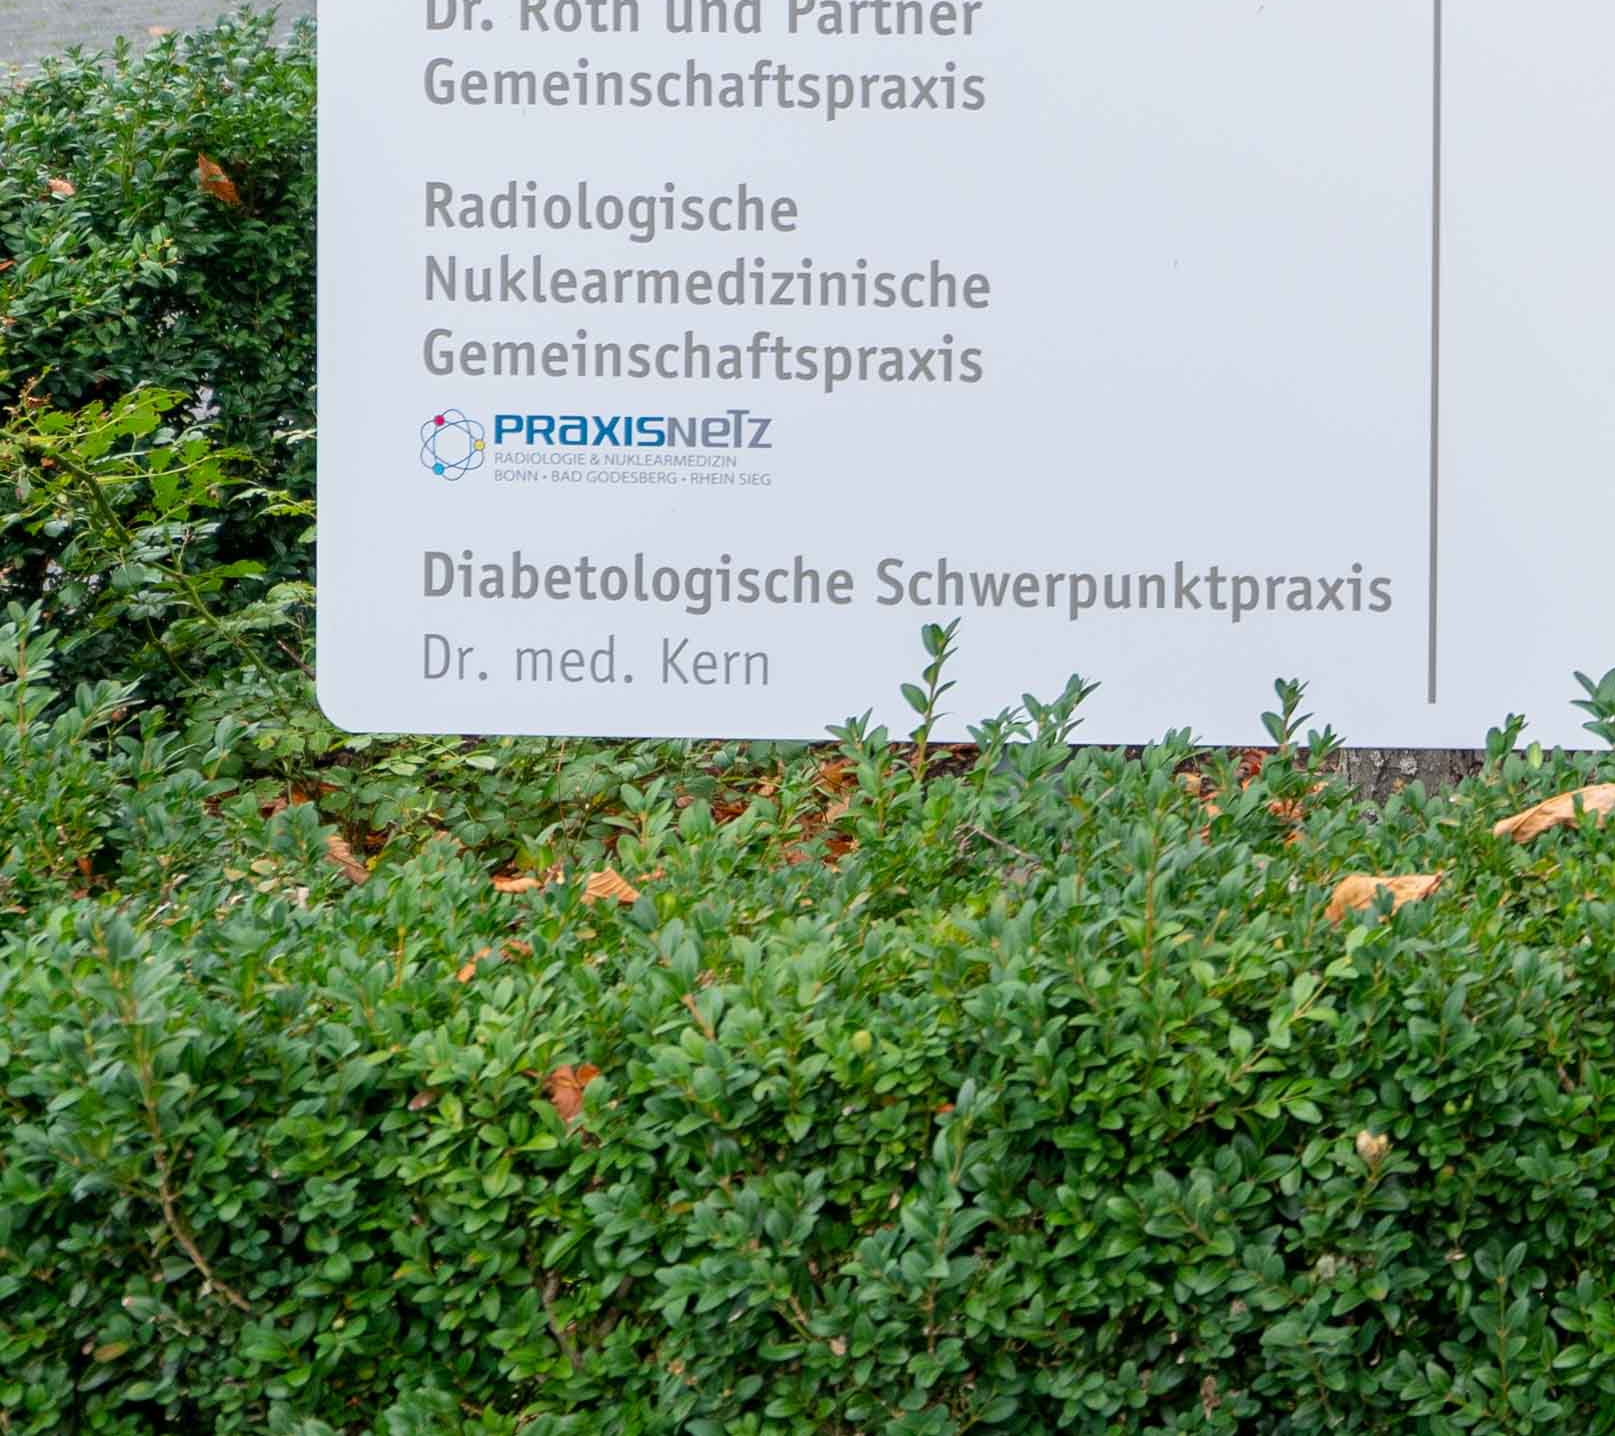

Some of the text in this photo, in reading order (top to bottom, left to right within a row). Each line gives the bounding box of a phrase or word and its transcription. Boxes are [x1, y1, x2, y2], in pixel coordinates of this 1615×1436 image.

[423, 57, 986, 122] Gemeinschaftspraxis
[425, 179, 798, 244] Radiologische
[425, 253, 992, 309] Nuklearmedizinische
[423, 327, 984, 394] Gemeinschaftspraxis
[493, 450, 737, 468] RADIOLOGIE & NUKLEARMEDIZIN
[494, 468, 772, 487] BONN BAD GODESBERG RHEIN SIEG
[423, 549, 1393, 624] Diabetologische Schwerpunktpraxis
[423, 633, 769, 686] Dr. med. Kern
